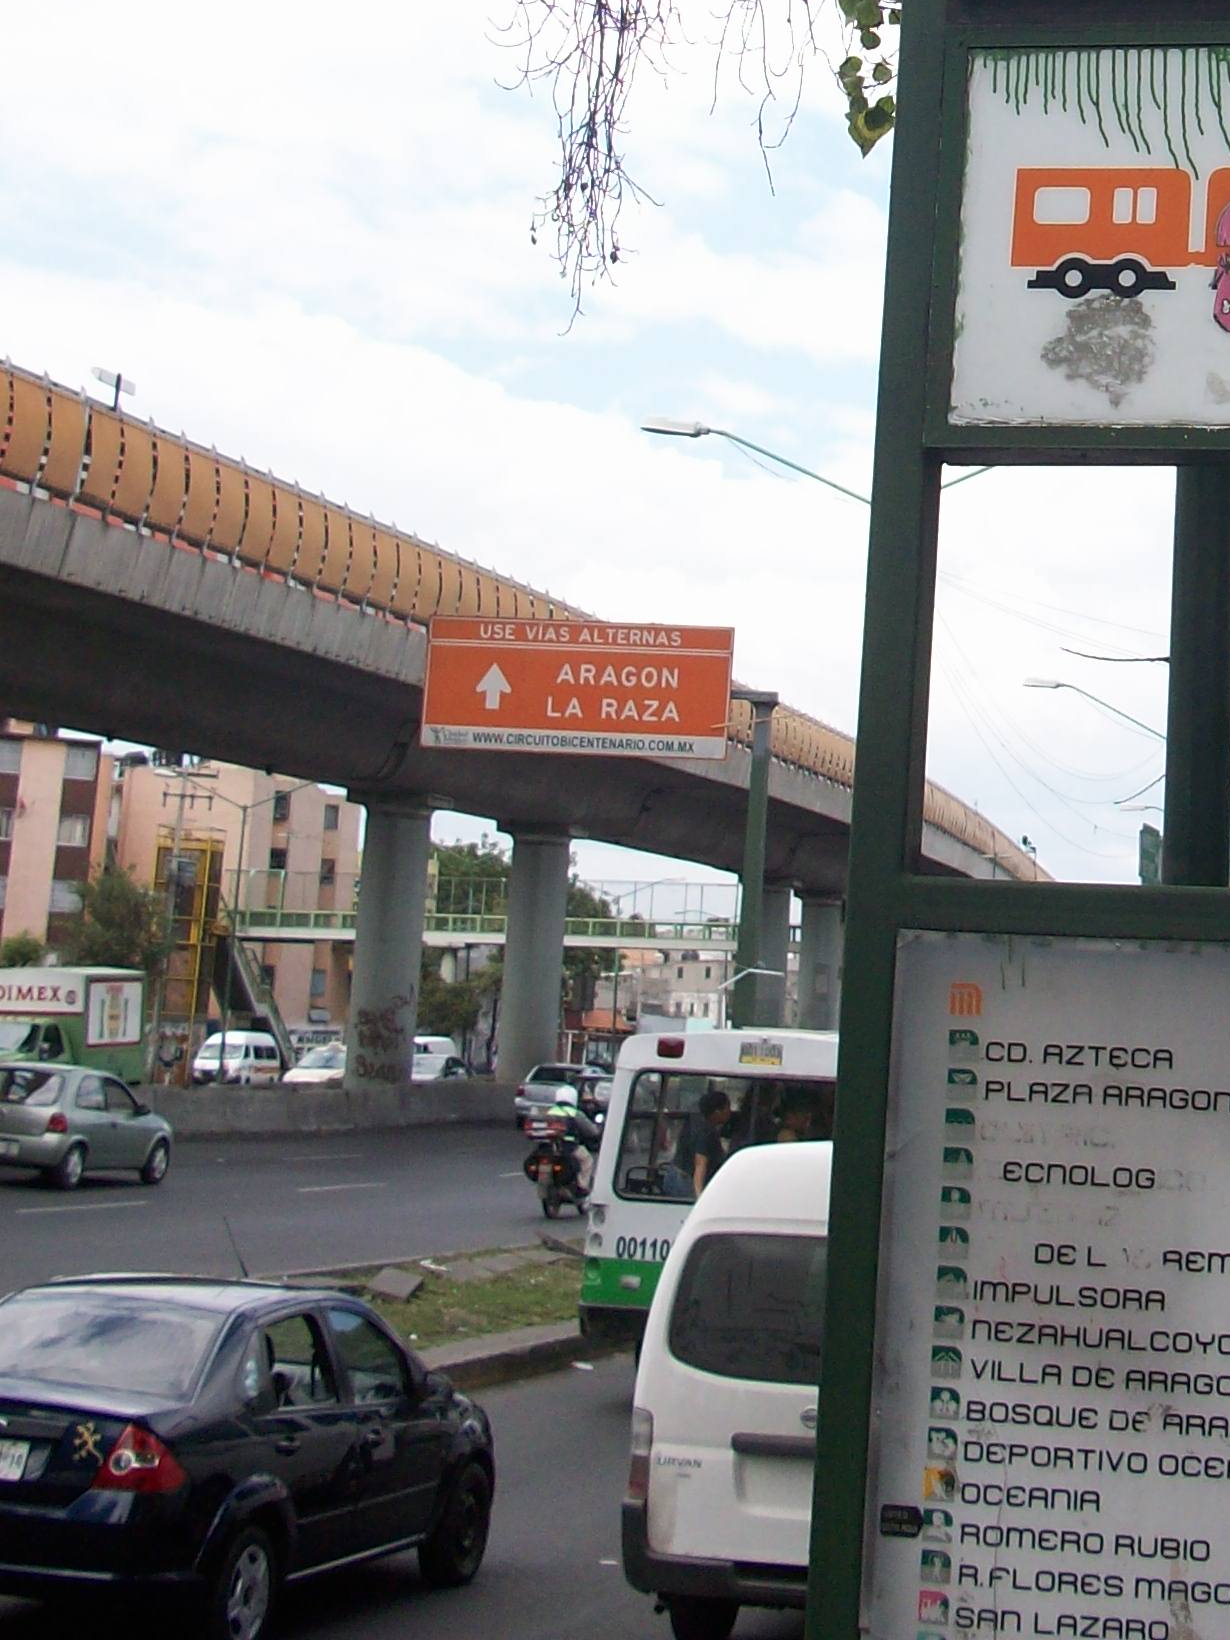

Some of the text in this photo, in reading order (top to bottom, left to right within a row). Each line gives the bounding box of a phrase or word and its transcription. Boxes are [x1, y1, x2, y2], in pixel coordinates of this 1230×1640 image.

[480, 623, 515, 639] USE
[579, 628, 682, 646] ALTERNAS
[556, 663, 679, 689] ARAGON
[546, 696, 681, 723] LA RAZA
[472, 730, 695, 754] WWW.CIRCUITOBICENTENARIO.COM.MX
[984, 1041, 1174, 1070] CD. AZTECA
[983, 1080, 1093, 1105] PLAZA
[1034, 1242, 1077, 1266] DE
[972, 1279, 1166, 1312] IMPULSORA
[970, 1358, 1063, 1387] VILLA
[1071, 1365, 1116, 1390] DE
[965, 1399, 1099, 1430] BOSQUE
[1109, 1409, 1149, 1433] DE
[961, 1440, 1149, 1475] DEPORTIVO
[960, 1482, 1101, 1513] OCEANIA
[959, 1522, 1211, 1563] ROMERO RUBIO
[954, 1606, 1170, 1640] SAN LAZARO
